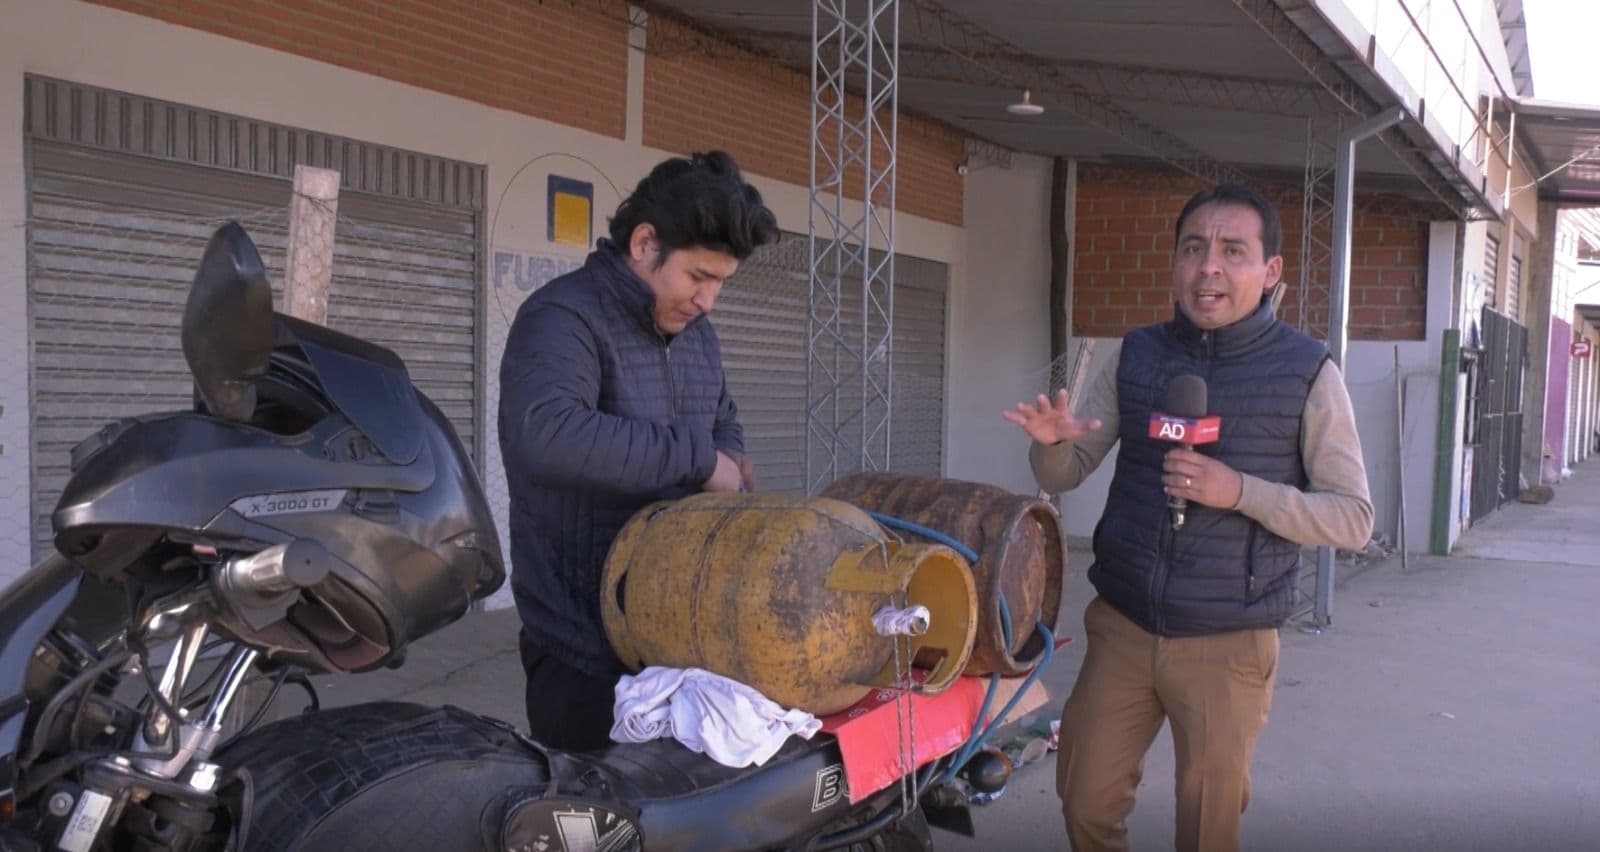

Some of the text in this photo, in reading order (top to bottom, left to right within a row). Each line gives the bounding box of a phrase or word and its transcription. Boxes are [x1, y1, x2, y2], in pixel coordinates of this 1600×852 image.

[1159, 422, 1185, 440] AD
[311, 498, 330, 509] GT
[811, 763, 851, 813] B
